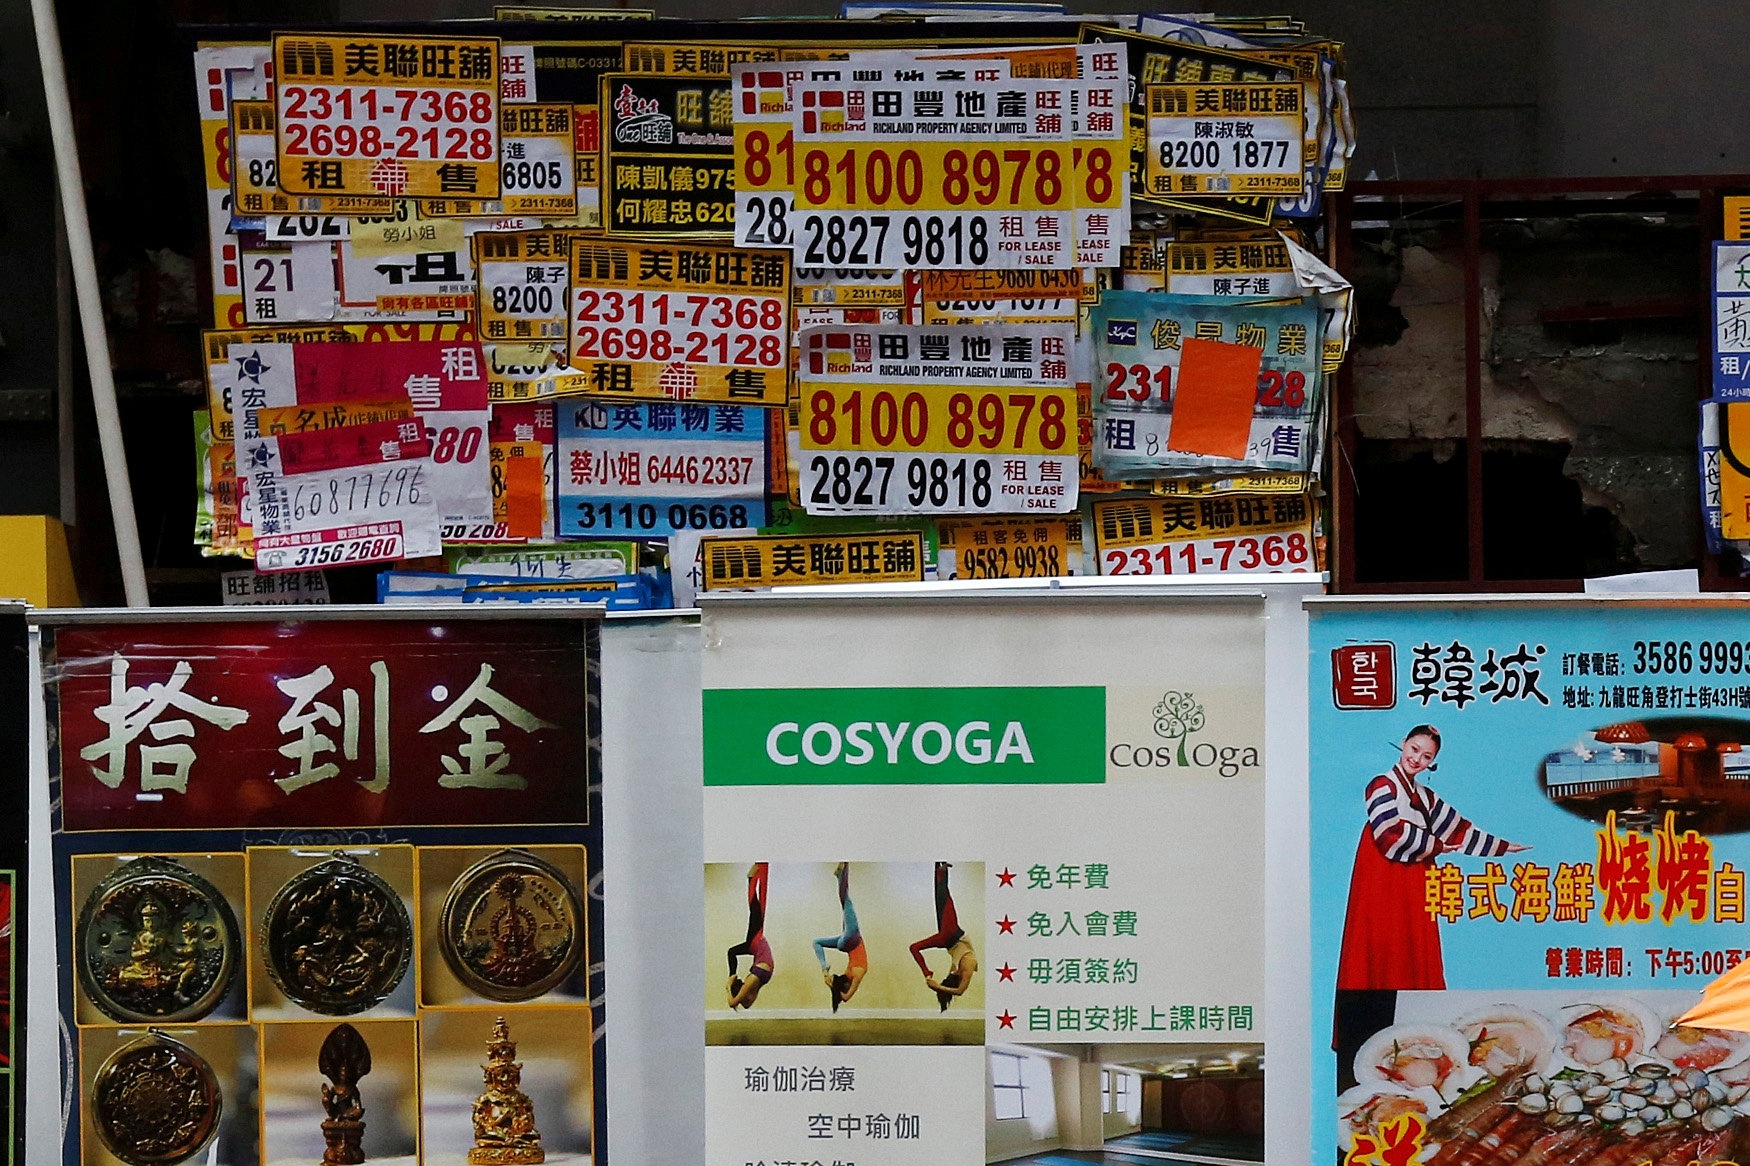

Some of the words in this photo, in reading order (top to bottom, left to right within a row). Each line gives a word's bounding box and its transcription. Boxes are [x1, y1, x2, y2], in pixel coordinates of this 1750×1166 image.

[344, 43, 492, 80] 美聯旺舖
[284, 88, 493, 124] 2311-7368
[872, 89, 1028, 118] 田豐地產
[1195, 87, 1298, 113] 美聯旺舖
[284, 124, 493, 160] 2698-2128
[873, 122, 915, 134] RICHLAND
[916, 122, 958, 134] PROPERTY
[959, 122, 993, 134] AGENCY
[994, 122, 1028, 134] LIMITED
[1194, 121, 1255, 140] 陳淑敏
[1159, 140, 1220, 169] 8200
[1232, 140, 1290, 169] 1877
[803, 149, 923, 206] 8100
[942, 149, 1063, 206] 8978
[1246, 176, 1301, 188] 2311-7368
[803, 215, 891, 265] 2827
[902, 215, 989, 266] 9818
[998, 240, 1022, 252] FOR
[1024, 241, 1061, 251] LEASE
[639, 250, 784, 288] 美聯旺舖
[1213, 278, 1270, 296] 陳子進
[577, 291, 783, 331] 2311-7368
[576, 327, 782, 366] 2698-2128
[878, 333, 1033, 363] 田豐地產
[613, 404, 746, 433] 英聯物業
[809, 389, 929, 447] 8100
[947, 392, 1067, 451] 8978
[570, 450, 642, 487] 蔡小姐
[810, 455, 895, 506] 2827
[907, 457, 992, 508] 9818
[577, 503, 657, 530] 3110
[668, 503, 748, 530] 0668
[1162, 495, 1306, 534] 美聯旺舖
[772, 538, 916, 577] 美聯旺舖
[1106, 532, 1309, 575] 2311-7368
[1350, 650, 1380, 701] 한국
[1407, 640, 1550, 710] 韓城
[1632, 640, 1694, 676] 3586
[80, 650, 560, 795] 拾到金
[764, 720, 1035, 766] COSYOGA
[1027, 863, 1110, 890] 免年費
[1027, 910, 1139, 938] 免入會費
[1027, 957, 1139, 985] 毋須簽約
[1028, 1005, 1254, 1033] 自由安排上課時間
[744, 1065, 856, 1093] 瑜伽治療
[807, 1112, 921, 1141] 空中瑜伽
